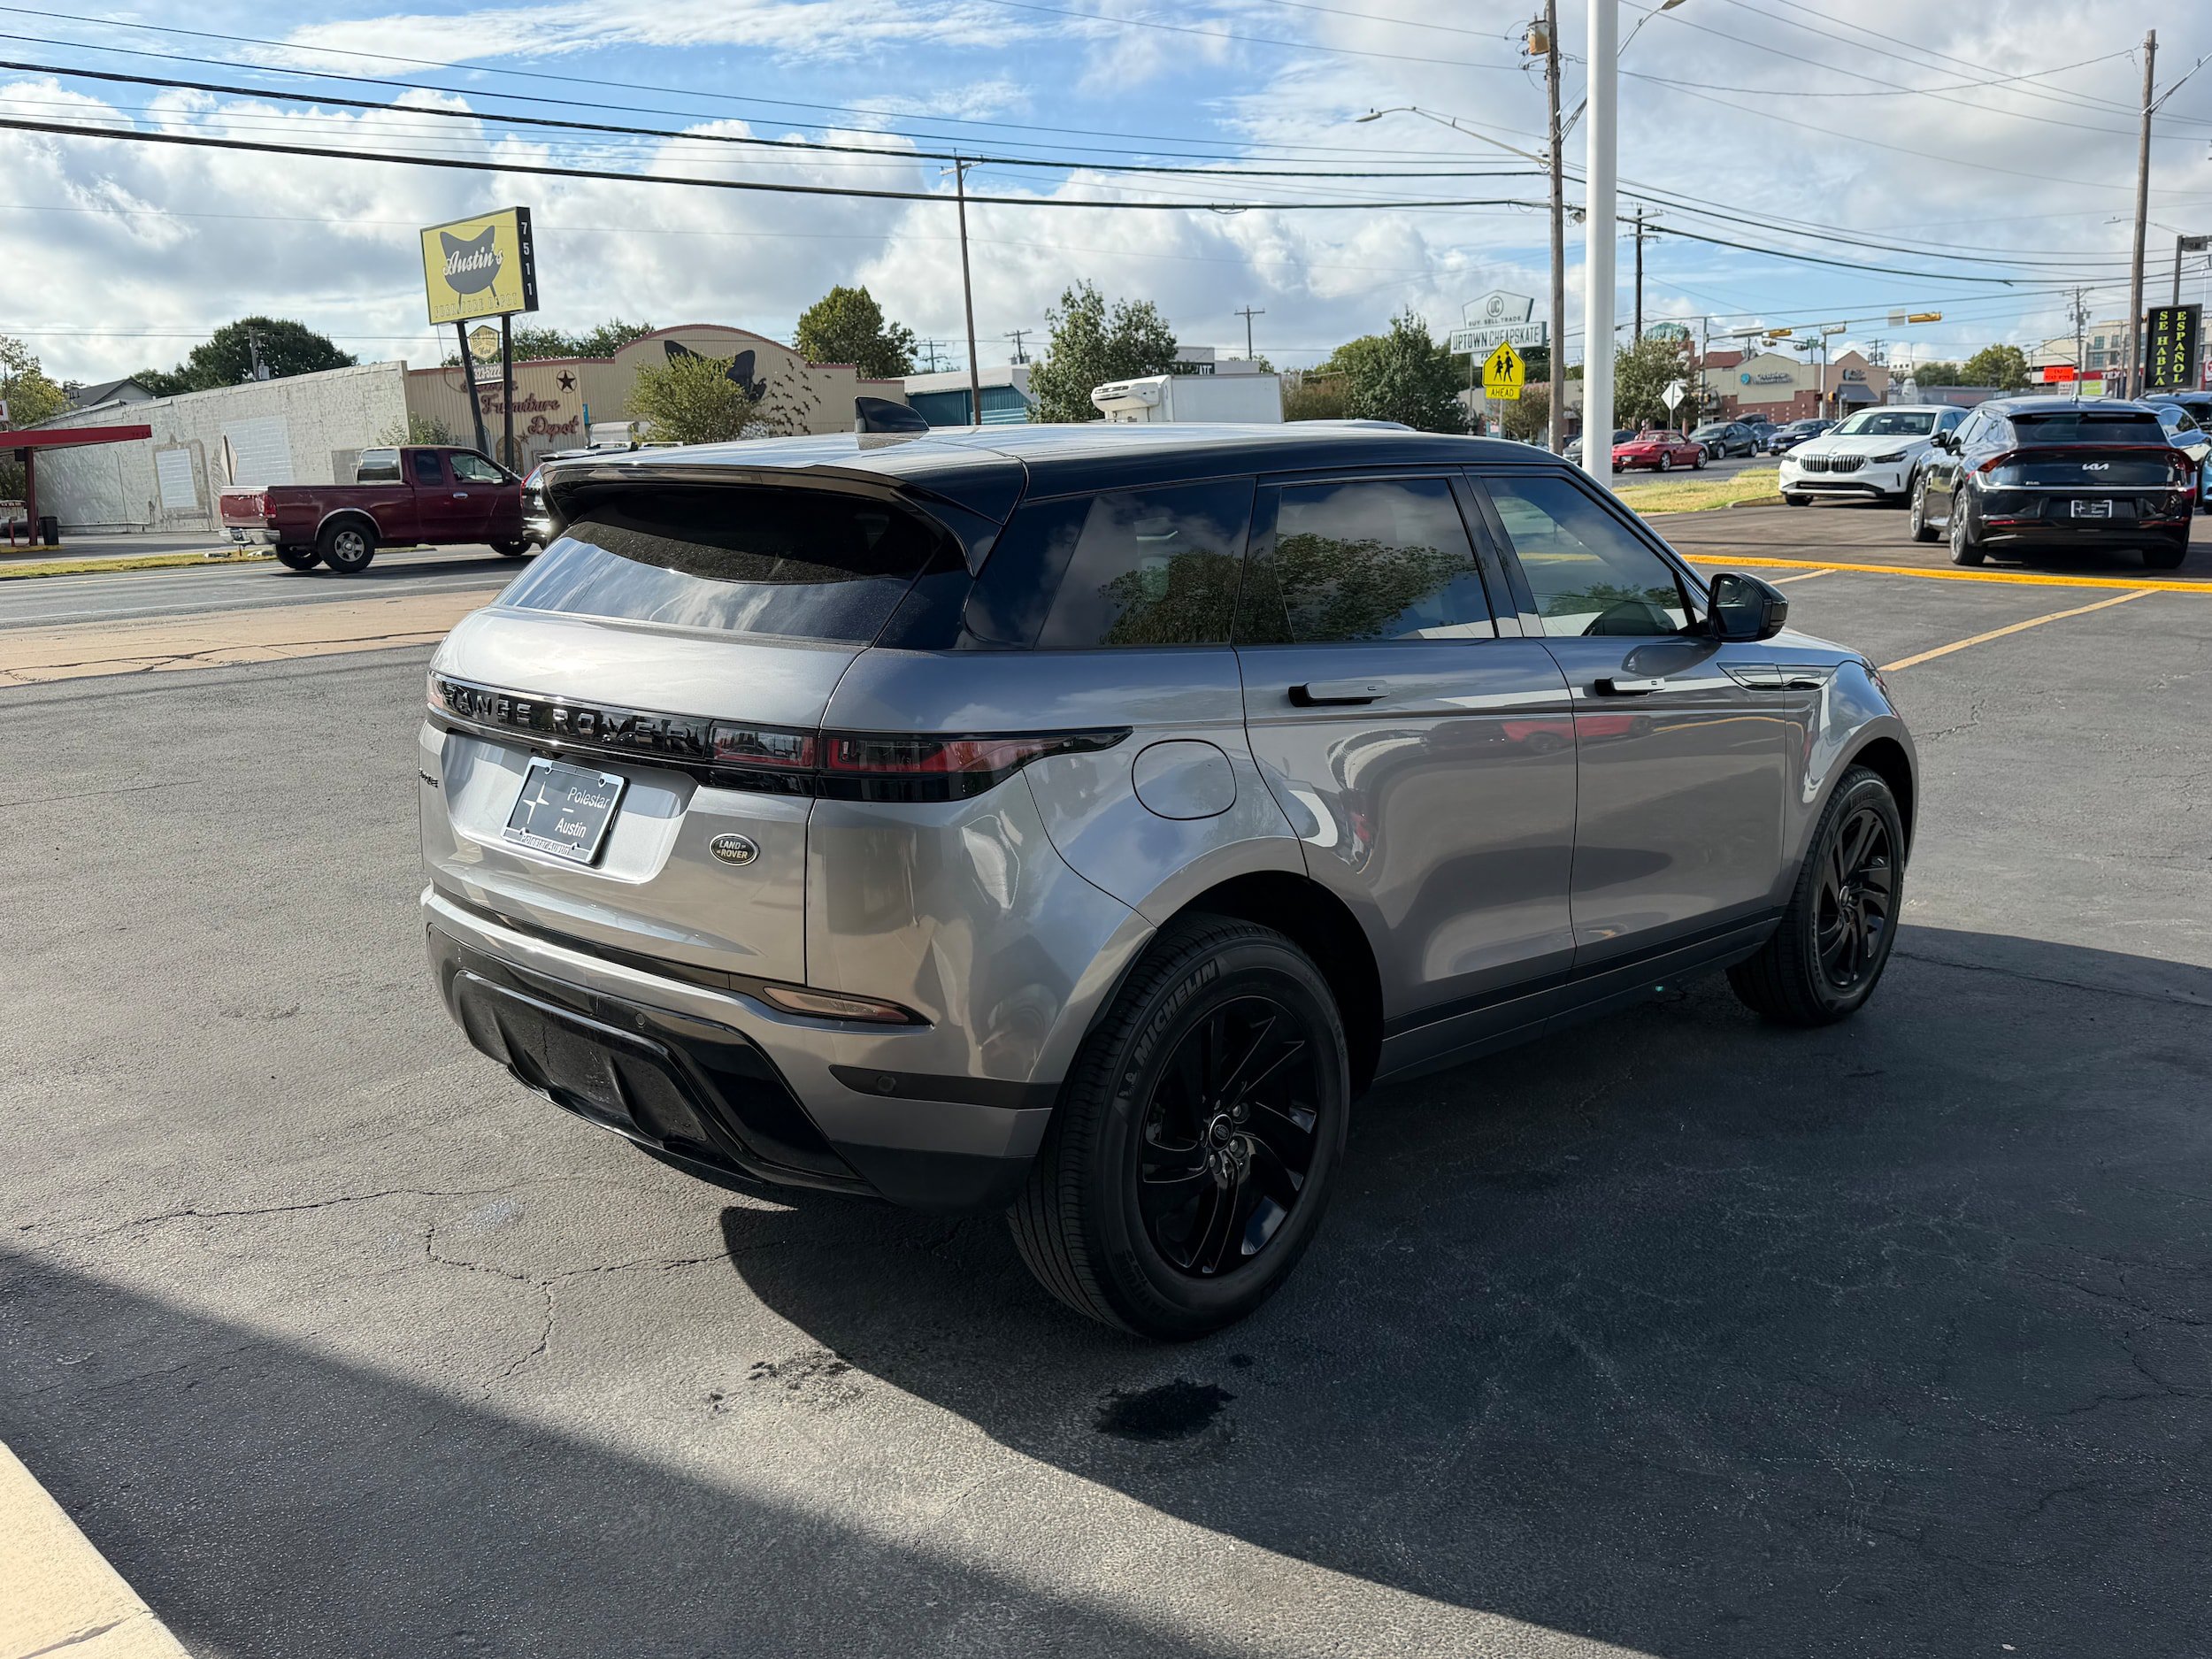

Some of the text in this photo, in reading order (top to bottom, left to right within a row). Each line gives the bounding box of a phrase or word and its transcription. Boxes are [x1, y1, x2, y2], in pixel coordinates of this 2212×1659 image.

[442, 243, 504, 275] Austin's
[520, 221, 533, 296] 7511
[1453, 326, 1540, 350] UPTOWN CHEAPSKATE
[2154, 311, 2169, 386] SE HABLA
[2172, 311, 2186, 383] ESPAÑOL
[481, 392, 560, 415] Funiture
[1490, 388, 1514, 397] AHEAD
[527, 415, 580, 442] Depot
[567, 787, 611, 809] Polestar
[554, 818, 588, 839] Austin
[520, 834, 571, 856] Polestar Austin
[718, 840, 741, 849] LAND
[720, 849, 749, 859] ROVER
[1133, 959, 1218, 1067] MICHELIN
